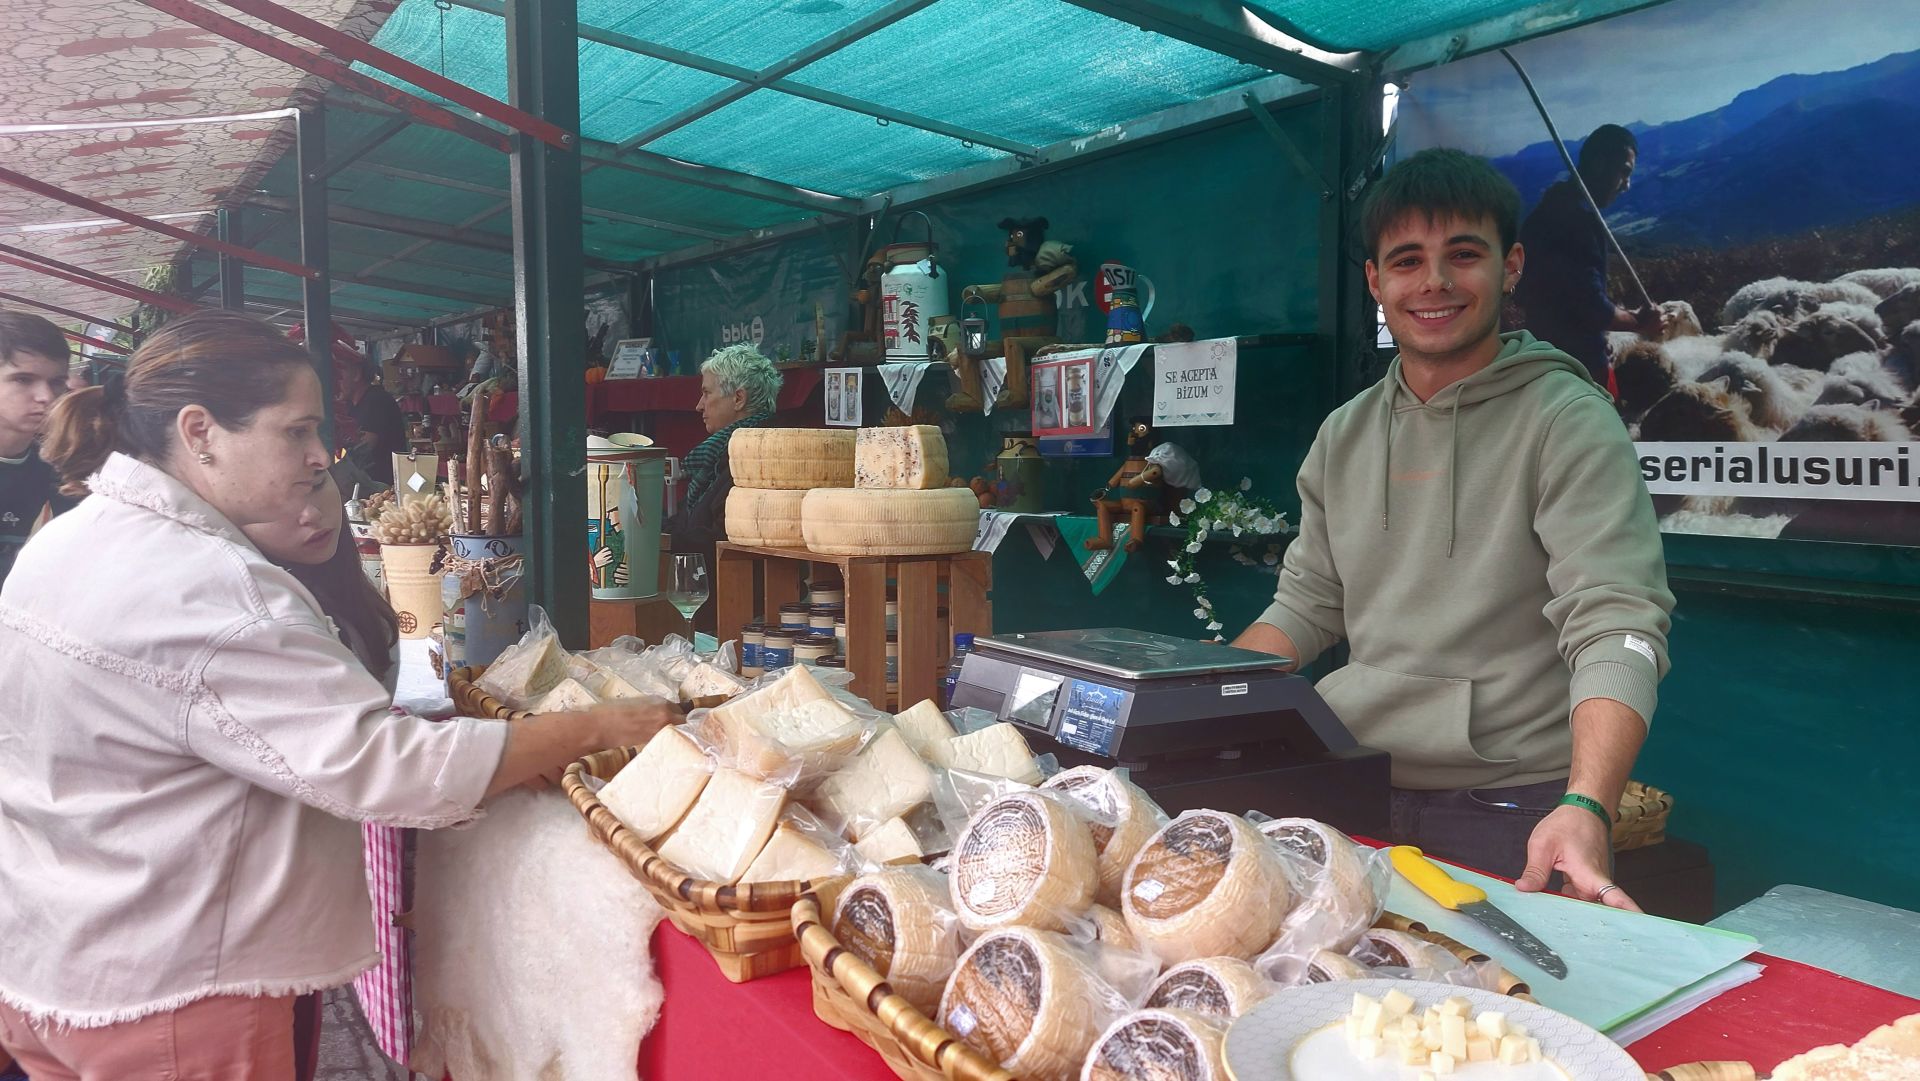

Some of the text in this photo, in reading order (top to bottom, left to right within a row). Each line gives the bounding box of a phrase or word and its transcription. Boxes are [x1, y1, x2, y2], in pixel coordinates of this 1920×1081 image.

[1165, 367, 1218, 384] SE ACEPTA
[1639, 446, 1920, 487] serialusuri
